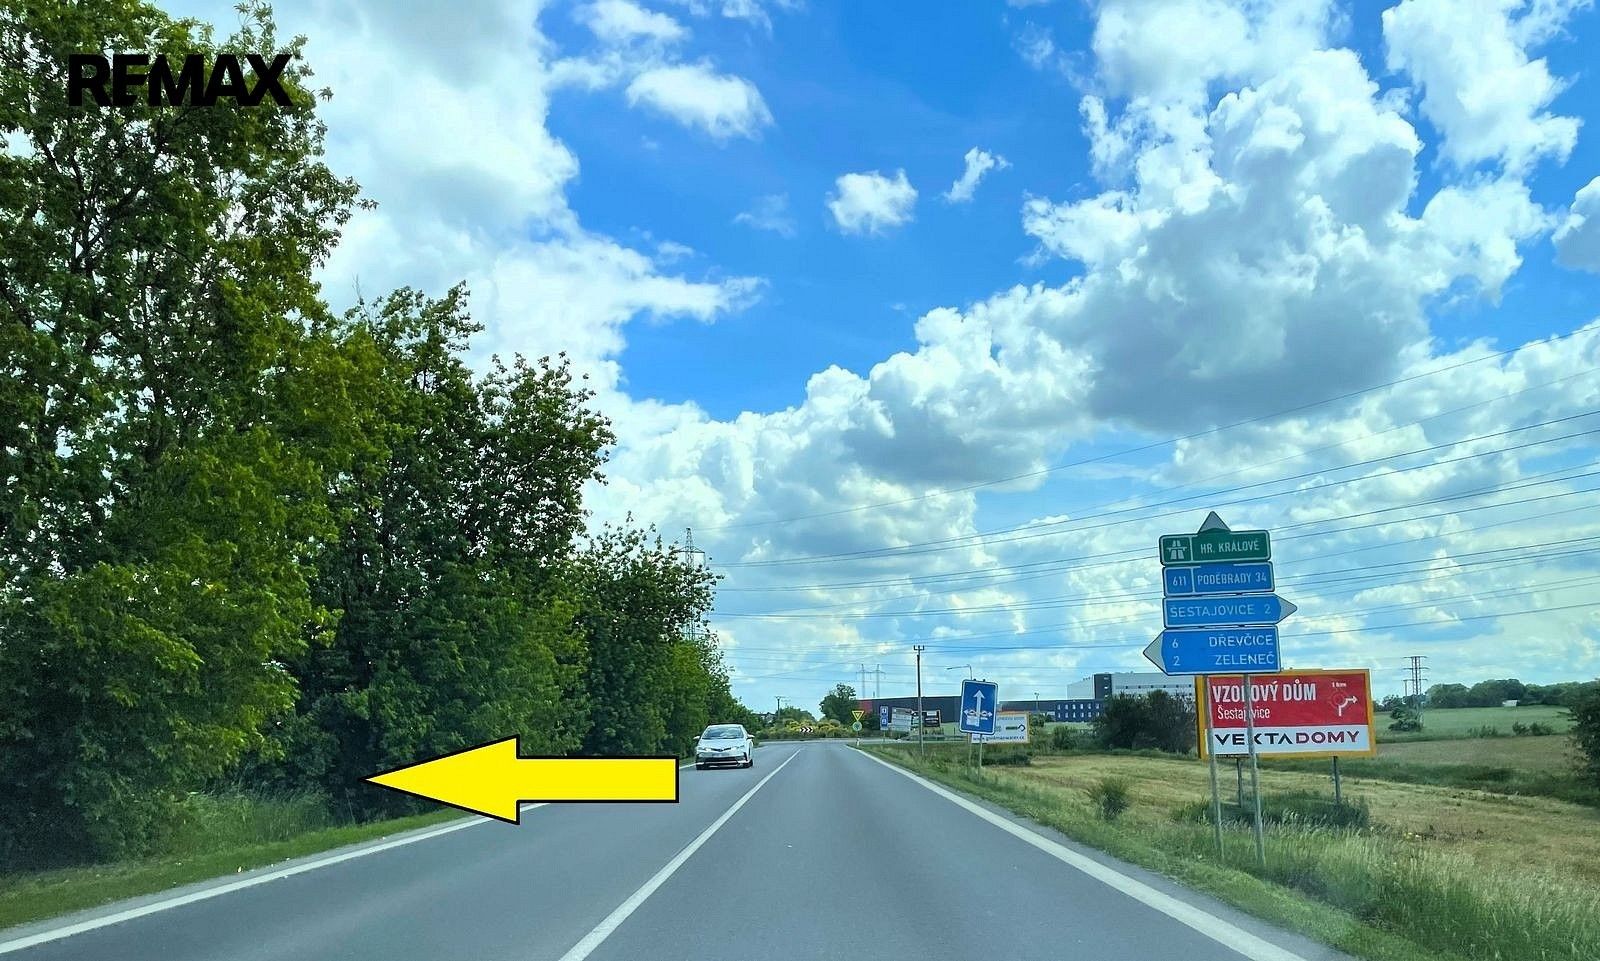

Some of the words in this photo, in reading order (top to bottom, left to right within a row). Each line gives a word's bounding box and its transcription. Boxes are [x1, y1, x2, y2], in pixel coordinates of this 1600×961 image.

[1200, 543, 1215, 554] HR.
[1172, 575, 1187, 586] 611
[1255, 572, 1267, 582] 34
[1264, 604, 1271, 614] 2
[1172, 639, 1179, 648] 6
[1209, 633, 1274, 647] DŘEVČICE
[1173, 656, 1180, 666] 2
[1215, 651, 1275, 665] ZELENEČ
[1283, 679, 1317, 701] DŮM
[1217, 705, 1271, 722] Šestajvice
